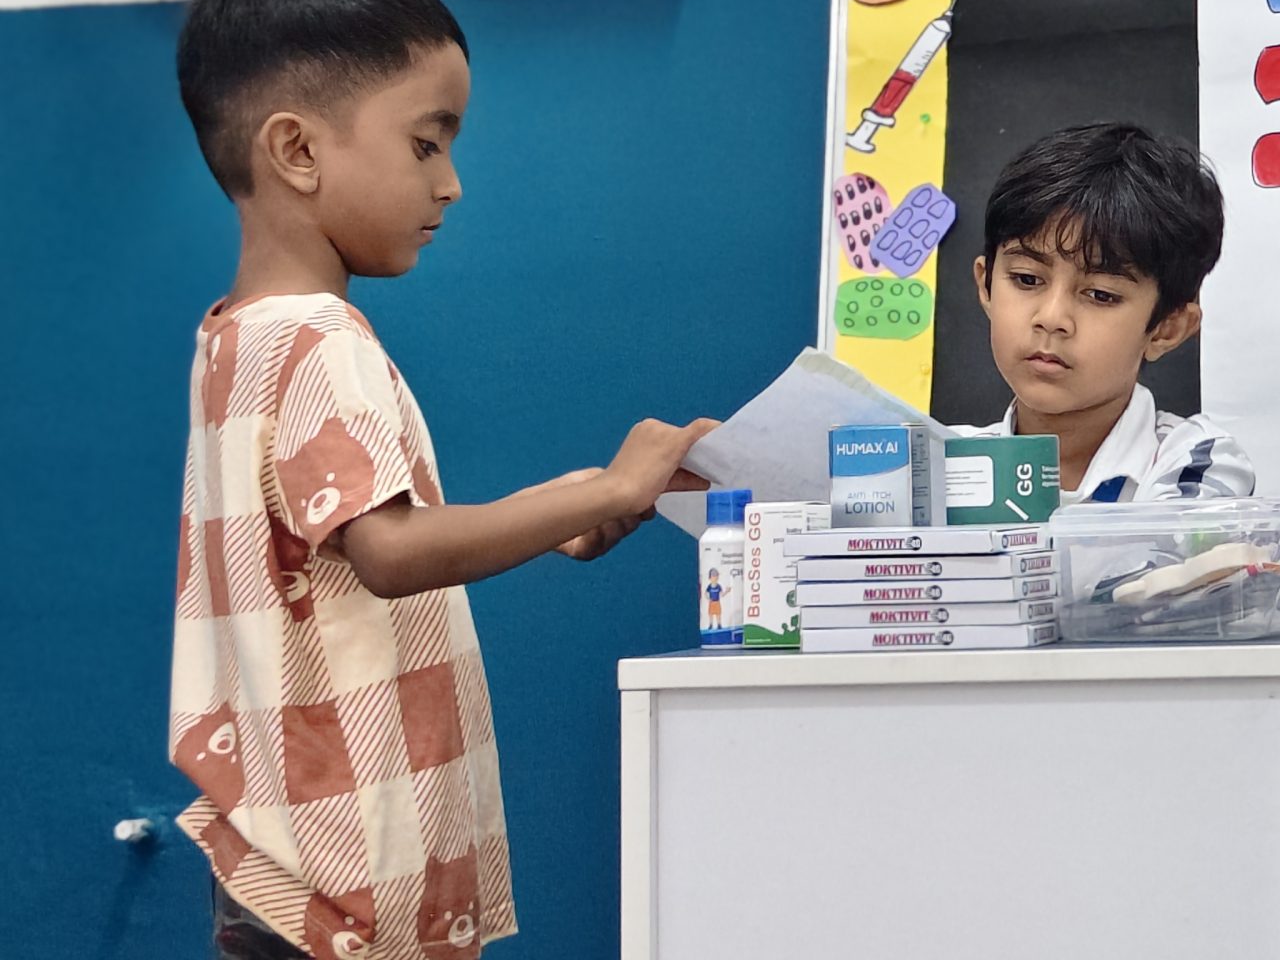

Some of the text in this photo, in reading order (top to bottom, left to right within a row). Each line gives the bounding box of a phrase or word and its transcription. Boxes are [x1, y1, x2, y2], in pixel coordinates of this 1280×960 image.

[836, 442, 883, 456] HUMAX
[1017, 463, 1033, 496] GG
[845, 501, 895, 515] LOTION
[848, 538, 905, 551] MOKTIVIT
[748, 512, 761, 618] BacSes GG
[865, 564, 924, 576] MOKTIVIT
[863, 588, 924, 600] MOKTIVIT
[870, 611, 930, 623] MOKTIVIT
[873, 633, 935, 646] MOKTIVIT
